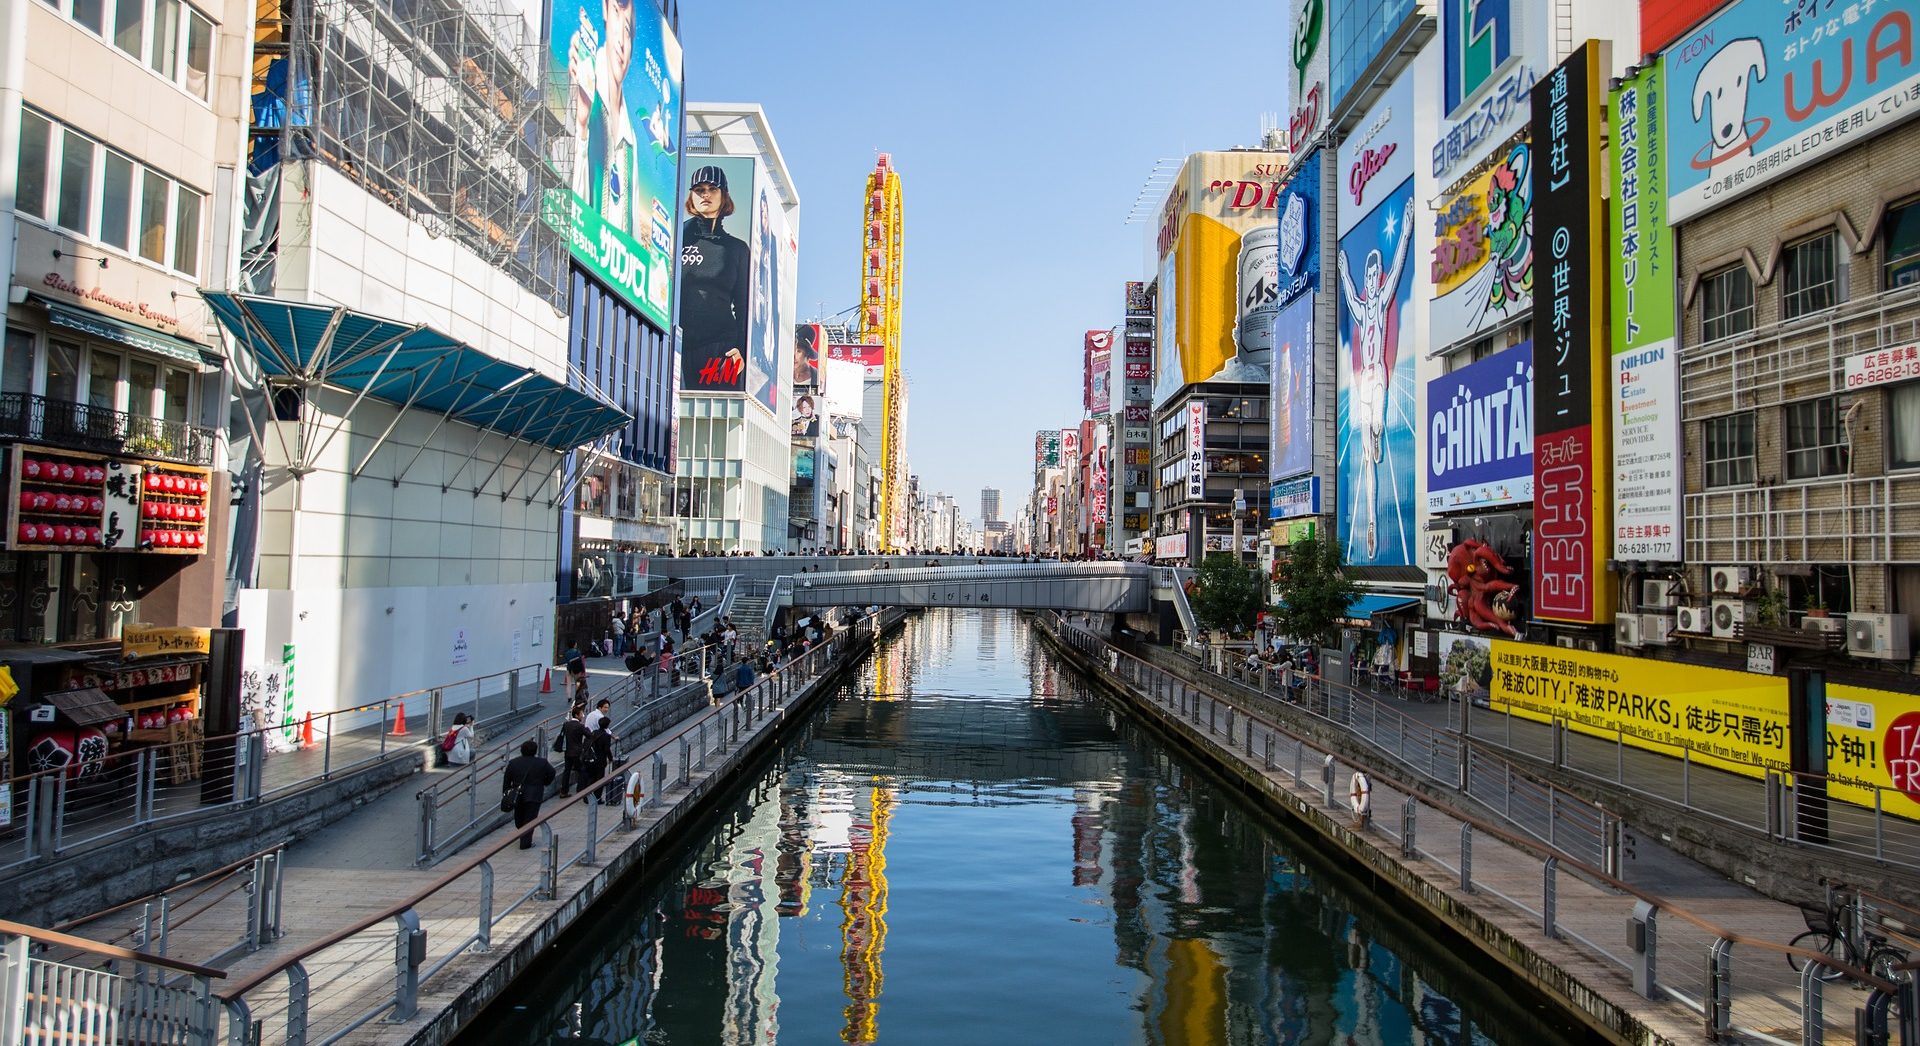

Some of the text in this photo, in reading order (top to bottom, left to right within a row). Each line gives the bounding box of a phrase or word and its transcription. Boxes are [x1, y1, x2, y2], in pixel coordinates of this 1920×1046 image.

[1349, 143, 1397, 206] Glico
[1645, 74, 1660, 277] 不動産再生のスペシャリスト
[1619, 88, 1640, 345] 株式会社日本リート
[600, 224, 647, 305] サロンパス
[1621, 347, 1665, 371] NIHON
[1864, 346, 1918, 370] 広告募集
[699, 356, 742, 386] H&M
[1621, 372, 1640, 385] Real
[1621, 386, 1646, 399] Estate
[1621, 399, 1657, 413] Investment
[1621, 412, 1658, 426] Technology
[1126, 428, 1148, 441] 白木屋
[1622, 425, 1649, 437] SERVICE
[1622, 434, 1655, 446] PROVIDER
[1618, 523, 1671, 539] 広告主募集中
[1618, 542, 1671, 554] 06-6281-1717
[1748, 645, 1773, 661] BAR
[1695, 739, 1712, 753] walk
[1713, 742, 1730, 758] from
[1731, 747, 1750, 763] here!
[1751, 750, 1763, 766] We
